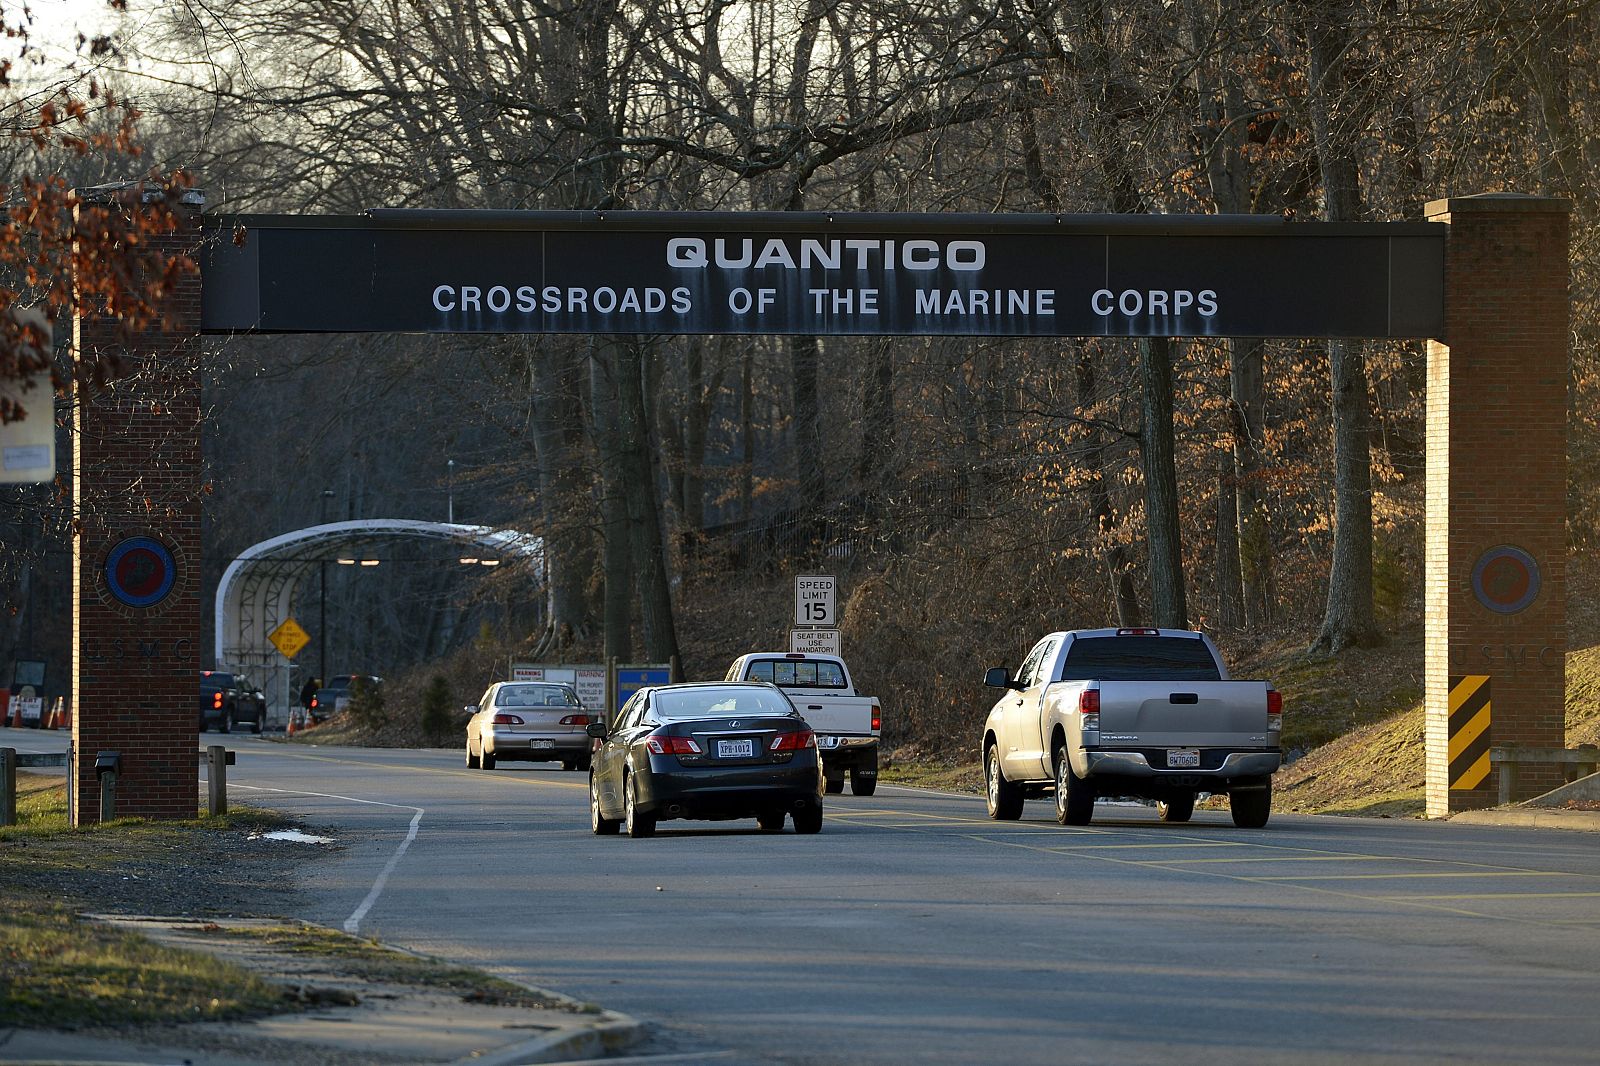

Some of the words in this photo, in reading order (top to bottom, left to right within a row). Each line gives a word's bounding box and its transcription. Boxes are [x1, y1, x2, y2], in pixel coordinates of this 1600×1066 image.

[667, 238, 986, 270] QUANTICO
[432, 285, 692, 314] CROSSROADS
[728, 287, 776, 314] OF
[809, 289, 879, 314] THE
[915, 289, 1056, 315] MARINE
[1091, 289, 1219, 316] CORPS
[799, 581, 833, 589] SPEED
[802, 591, 828, 599] LIMIT
[804, 602, 827, 621] 15
[796, 632, 815, 640] SEAT
[817, 632, 834, 640] BELT
[1169, 756, 1198, 765] 8W70608
